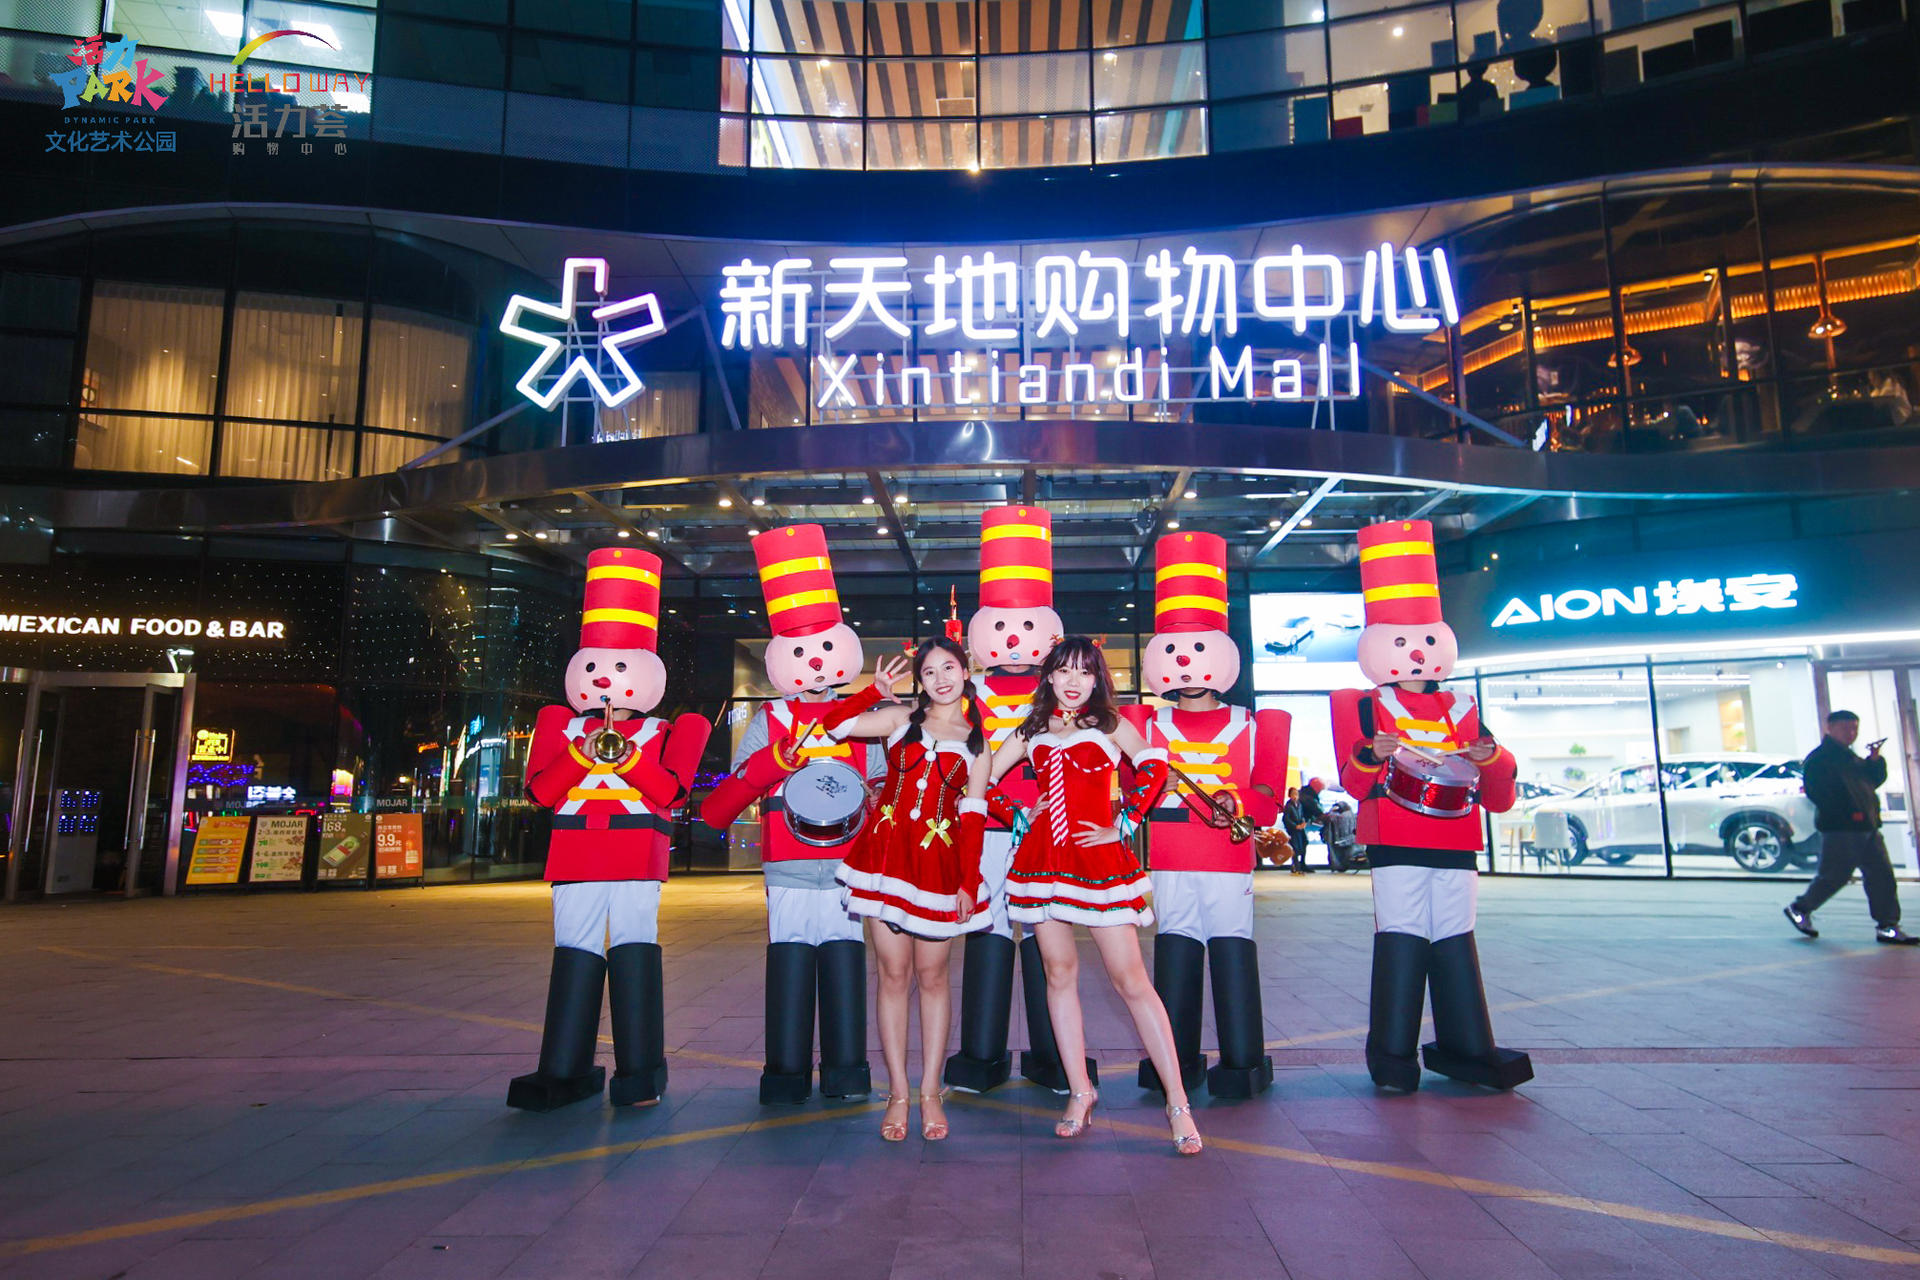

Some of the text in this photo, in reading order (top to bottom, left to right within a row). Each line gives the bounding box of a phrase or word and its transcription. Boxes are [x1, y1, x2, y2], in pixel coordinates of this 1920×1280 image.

[720, 242, 1460, 350] 新天地购物中心
[817, 341, 1361, 409] Xintiandi Mall
[1491, 573, 1799, 627] AION 埃安
[0, 613, 285, 639] MEXICAN FOOD & BAR
[376, 798, 408, 807] MOJAR
[270, 820, 303, 828] MOJAR
